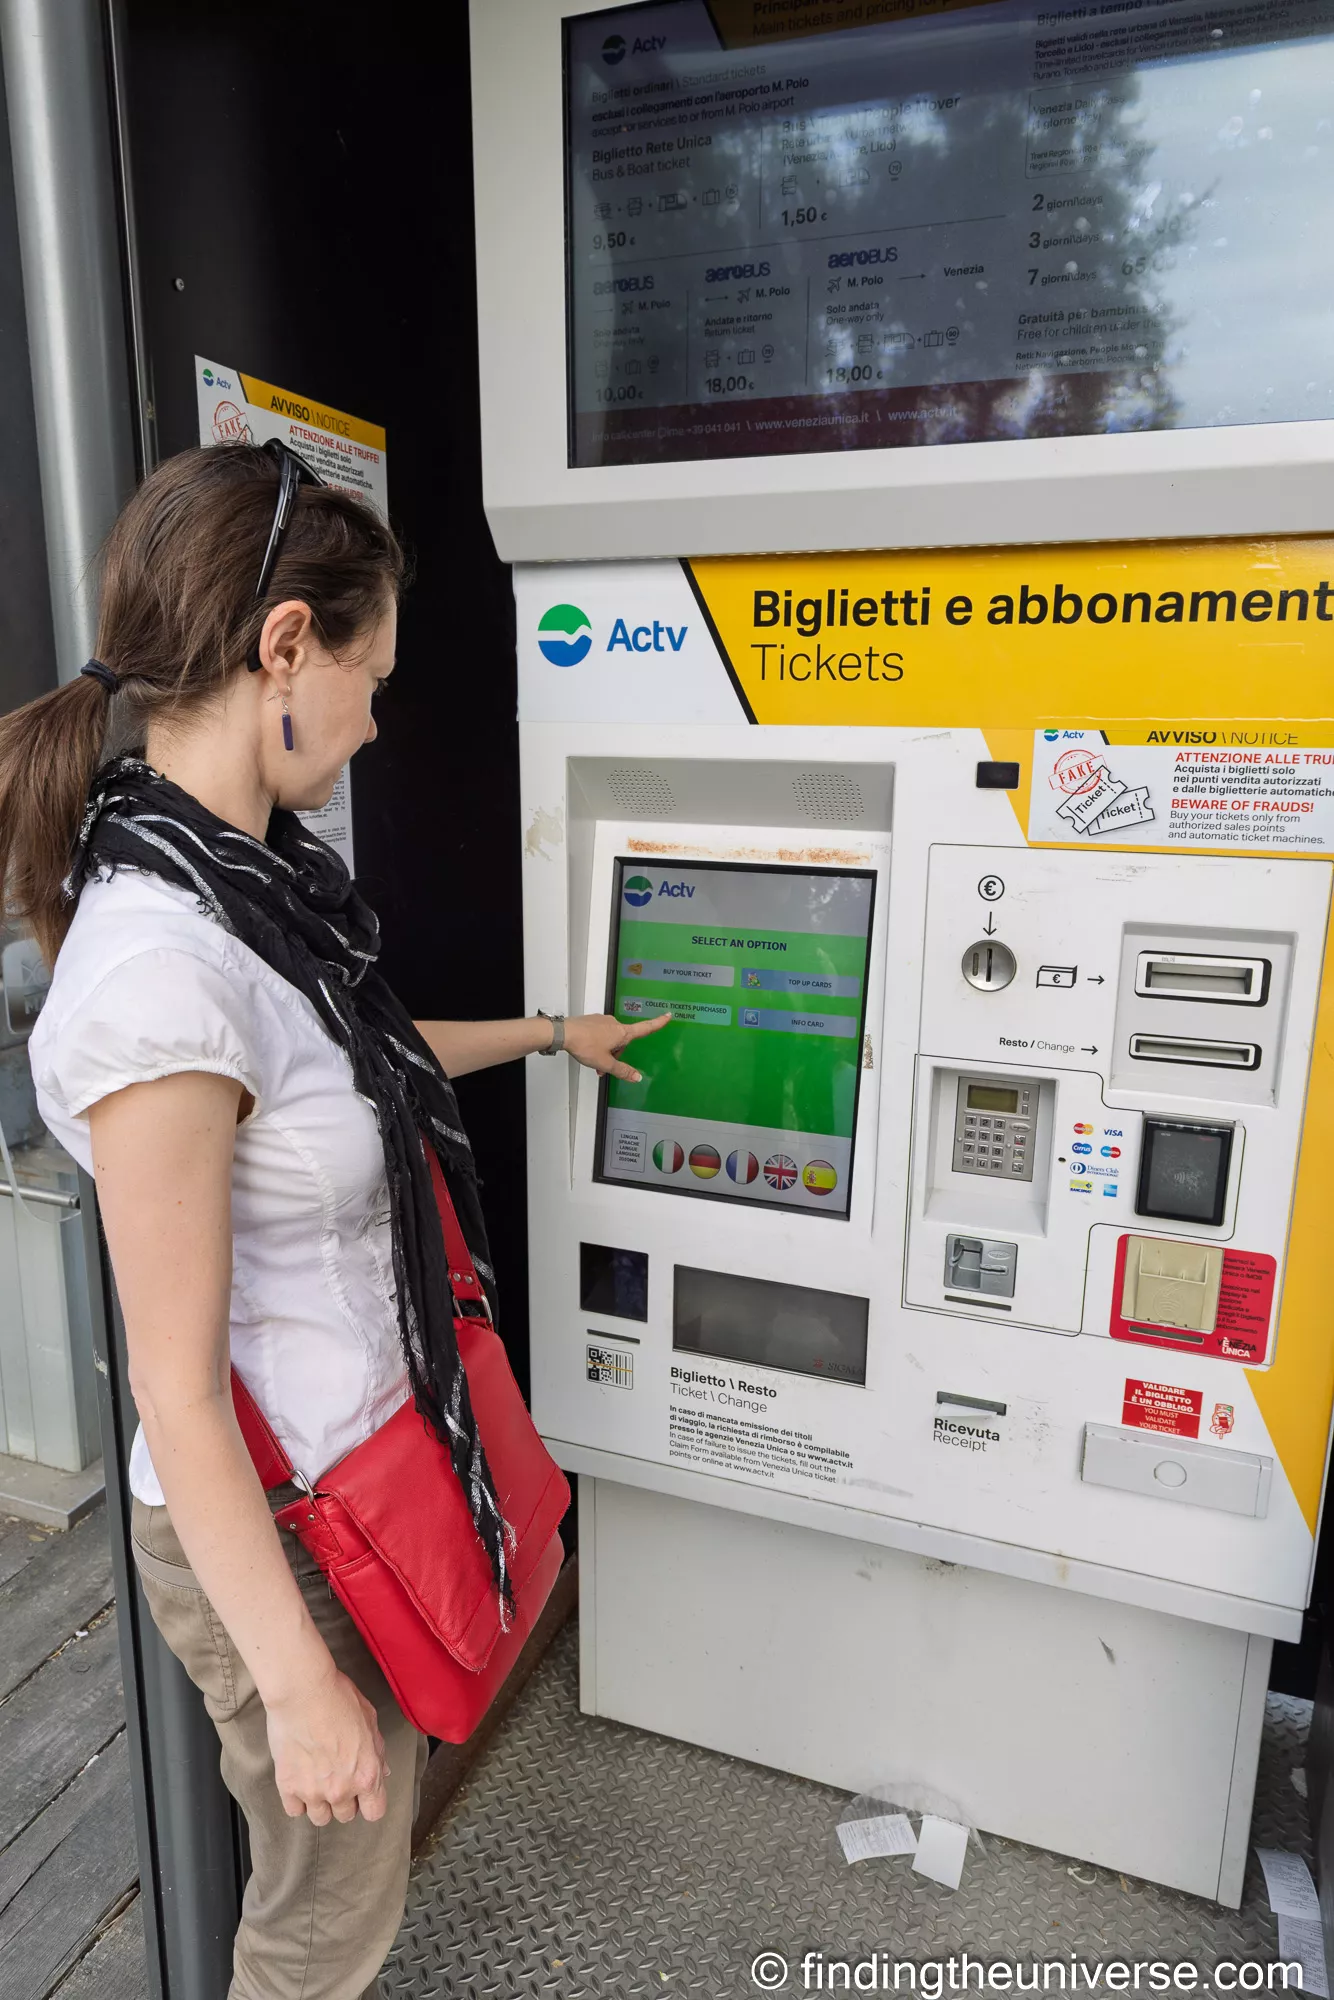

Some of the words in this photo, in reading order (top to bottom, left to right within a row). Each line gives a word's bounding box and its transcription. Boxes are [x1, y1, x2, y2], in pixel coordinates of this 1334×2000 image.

[632, 35, 667, 55] Actv
[592, 145, 643, 164] Biglietto
[646, 141, 674, 155] Rete
[676, 135, 712, 150] Unica
[592, 167, 614, 181] Bus
[616, 166, 625, 178] &
[627, 162, 654, 176] Boat
[656, 156, 690, 172] ticket
[1032, 194, 1044, 211] 2
[781, 206, 817, 227] 1,50
[592, 232, 626, 250] 9,50
[1028, 232, 1041, 248] 3
[943, 265, 984, 277] Venezia
[1028, 269, 1039, 286] 7
[847, 278, 859, 288] M.
[862, 276, 884, 286] Polo
[756, 288, 767, 298] M.
[769, 286, 790, 297] Polo
[826, 364, 872, 384] 18,00
[216, 377, 231, 390] Actv
[705, 376, 746, 394] 18,00
[271, 396, 310, 421] AVVISO
[316, 413, 350, 436] NOTICE
[755, 411, 868, 431] www.veneziaunica.it
[218, 418, 242, 440] FAKE
[290, 425, 334, 448] ATTENZIONE
[336, 441, 352, 455] ALLE
[753, 587, 931, 637] Biglietti
[944, 597, 973, 626] e
[987, 582, 1334, 626] abbonament
[606, 618, 688, 652] Actv
[750, 644, 904, 682] Tickets
[1062, 730, 1084, 739] Actv
[1146, 731, 1217, 744] AVVISO
[1231, 731, 1298, 745] NOTICE
[1175, 752, 1262, 764] ATTENZIONE
[1265, 754, 1300, 764] ALLE
[1304, 754, 1334, 765] TRU
[1058, 761, 1095, 784] FAKE
[1174, 765, 1220, 776] Acquista
[1228, 766, 1270, 776] biglietti
[1272, 766, 1296, 775] solo
[1174, 775, 1189, 783] nei
[1192, 776, 1218, 786] punti
[1222, 776, 1260, 784] vendita
[1264, 777, 1322, 786] autorizzati
[1182, 785, 1206, 794] dalle
[1209, 786, 1268, 796] biglietterie
[1074, 786, 1106, 814] Ticket
[1171, 799, 1228, 810] BEWARE
[1231, 800, 1250, 810] OF
[1253, 801, 1314, 812] FRAUDS!
[1170, 810, 1189, 821] Buy
[1190, 812, 1212, 822] your
[1216, 812, 1250, 822] tickets
[1252, 814, 1274, 824] only
[1276, 814, 1300, 823] from
[1169, 822, 1222, 830] authorized
[1224, 822, 1250, 832] sales
[1253, 824, 1286, 834] points
[1168, 831, 1186, 839] and
[1190, 832, 1239, 842] automatic
[1242, 833, 1270, 842] ticket
[1273, 835, 1325, 845] machines.
[658, 881, 696, 898] Actv
[692, 936, 728, 947] SELECT
[730, 939, 744, 948] AN
[747, 940, 787, 952] OPTION
[812, 980, 832, 989] CARDS
[670, 1003, 692, 1011] TICKETS
[692, 1004, 728, 1014] PURCHASED
[674, 1012, 696, 1020] ONLINE
[808, 1020, 824, 1028] CARD
[999, 1037, 1028, 1048] Resto
[1037, 1040, 1075, 1053] Change
[1104, 1128, 1123, 1137] VISA
[1222, 1347, 1250, 1358] UNICA
[670, 1366, 726, 1388] Biglietto
[738, 1380, 777, 1398] Resto
[1142, 1382, 1186, 1396] VALIDARE
[670, 1382, 708, 1401] Ticket
[718, 1392, 768, 1413] Change
[1134, 1388, 1143, 1396] IL
[1145, 1390, 1192, 1405] BIGLIETTO
[1139, 1398, 1152, 1406] UN
[1154, 1401, 1194, 1413] OBBLIGO
[1144, 1407, 1158, 1415] YOU
[1160, 1410, 1179, 1418] MUST
[678, 1407, 696, 1416] caso
[706, 1414, 738, 1426] mancata
[740, 1420, 779, 1434] emissione
[780, 1429, 792, 1437] dei
[794, 1432, 812, 1441] titoli
[1139, 1422, 1158, 1432] YOUR
[1158, 1425, 1181, 1435] TICKET
[1144, 1415, 1176, 1426] VALIDATE
[934, 1418, 1000, 1442] Ricevuta
[670, 1424, 695, 1434] presso
[696, 1428, 703, 1436] le
[704, 1432, 734, 1442] agenzie
[736, 1437, 764, 1449] Venezia
[766, 1444, 788, 1454] Unica
[808, 1454, 854, 1468] www.actv.it
[717, 1424, 750, 1437] richiesta
[760, 1434, 796, 1446] rimborso
[804, 1444, 850, 1459] compilabile
[933, 1430, 987, 1452] Receipt
